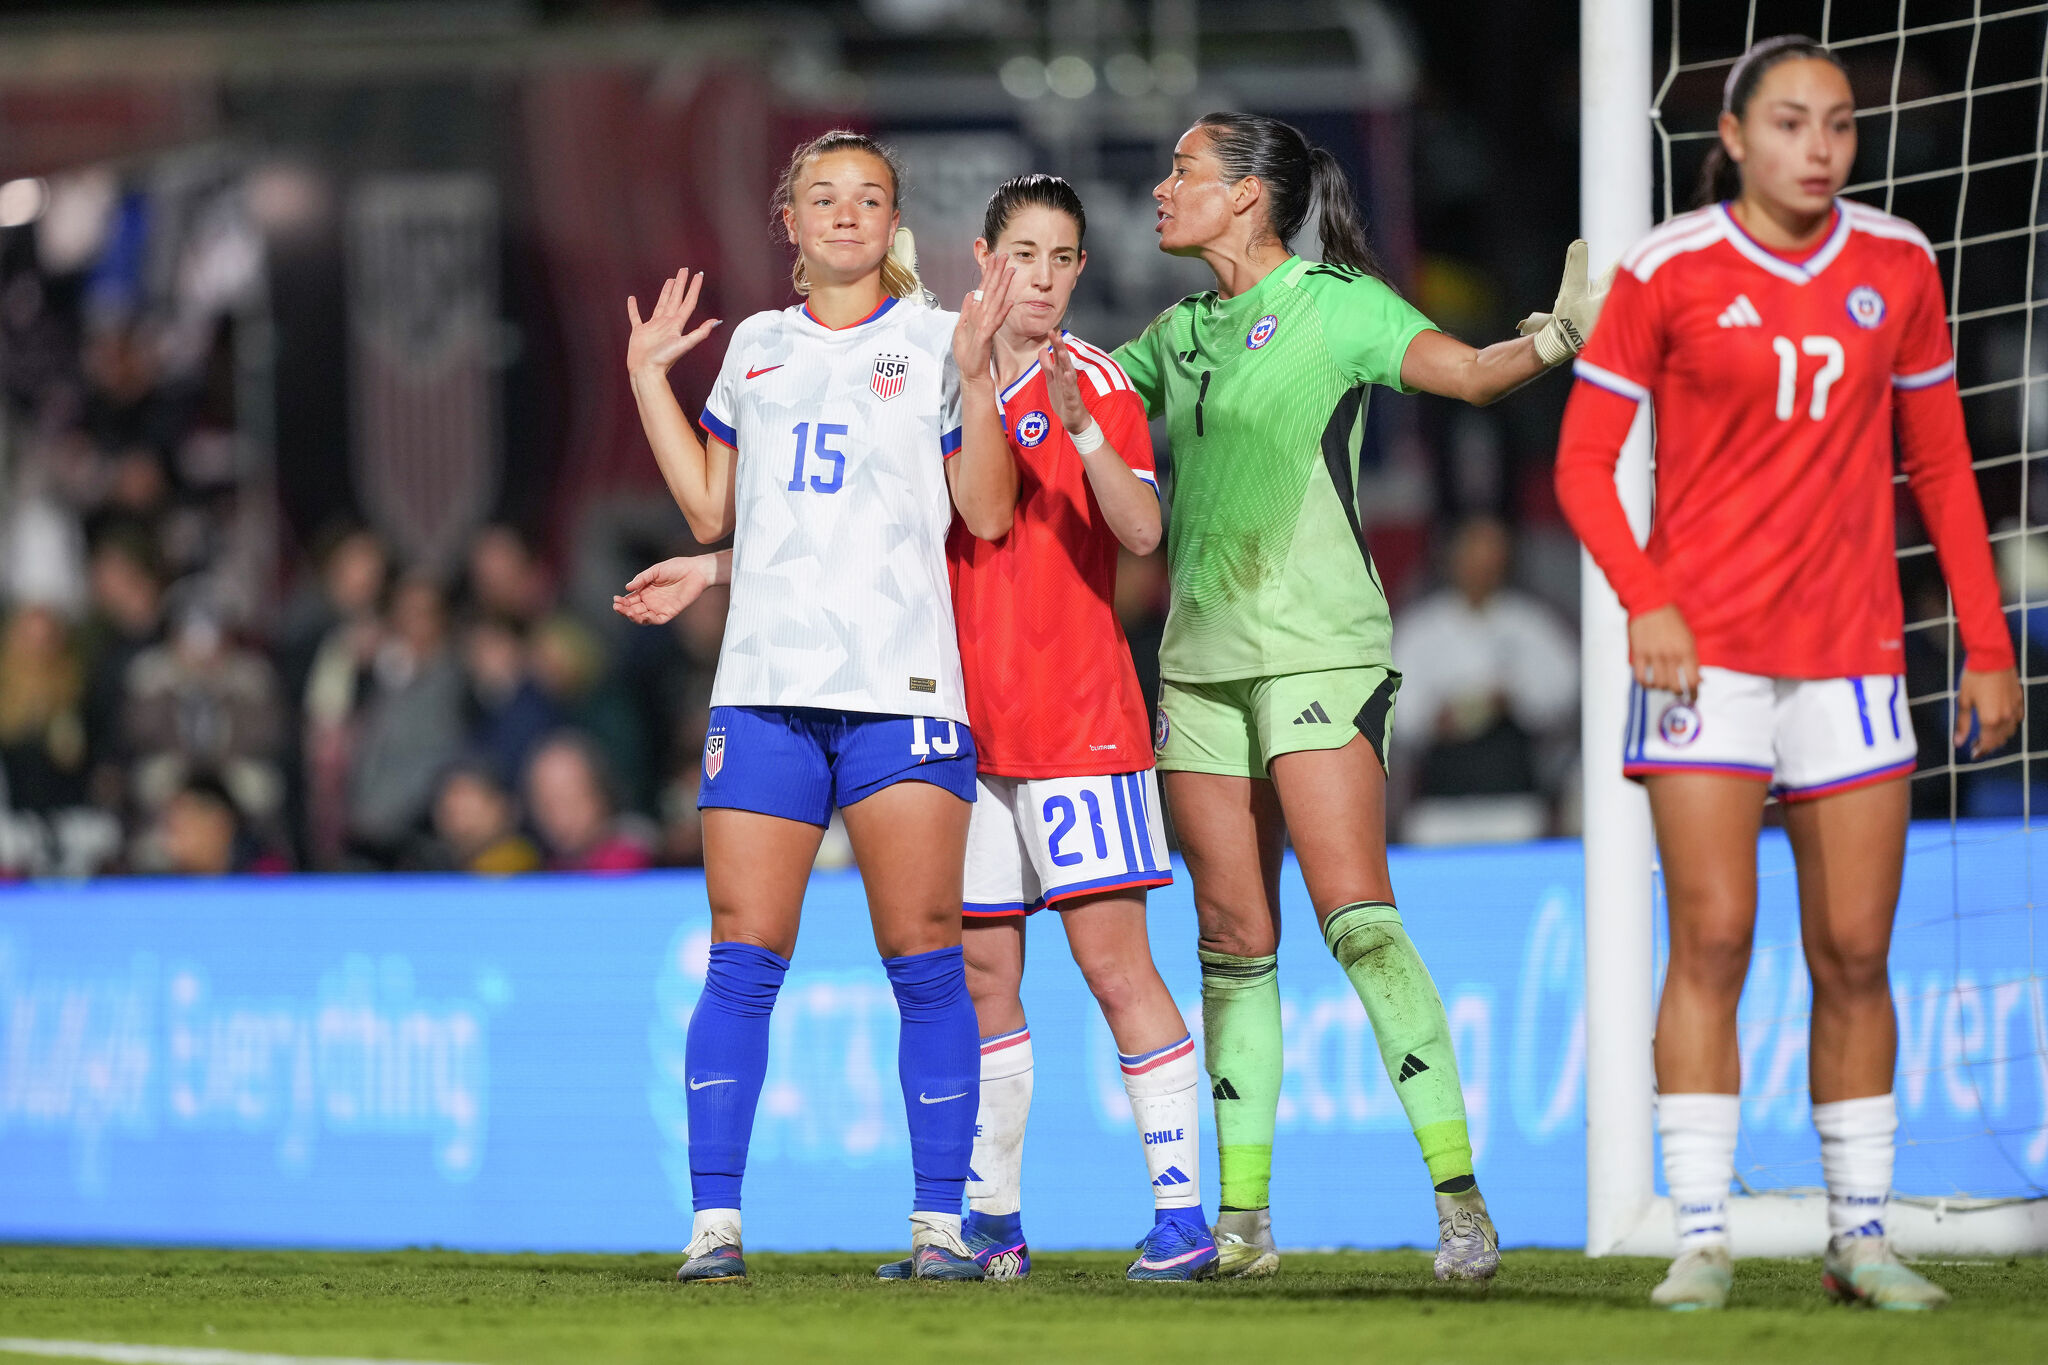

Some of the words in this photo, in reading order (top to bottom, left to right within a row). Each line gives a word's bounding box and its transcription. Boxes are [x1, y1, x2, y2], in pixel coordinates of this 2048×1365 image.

[875, 361, 906, 378] USA
[1772, 335, 1845, 421] 17
[1195, 370, 1211, 437] 1
[787, 421, 849, 495] 15
[707, 737, 724, 755] USA
[1042, 789, 1108, 868] 21
[1143, 1128, 1184, 1145] CHILE
